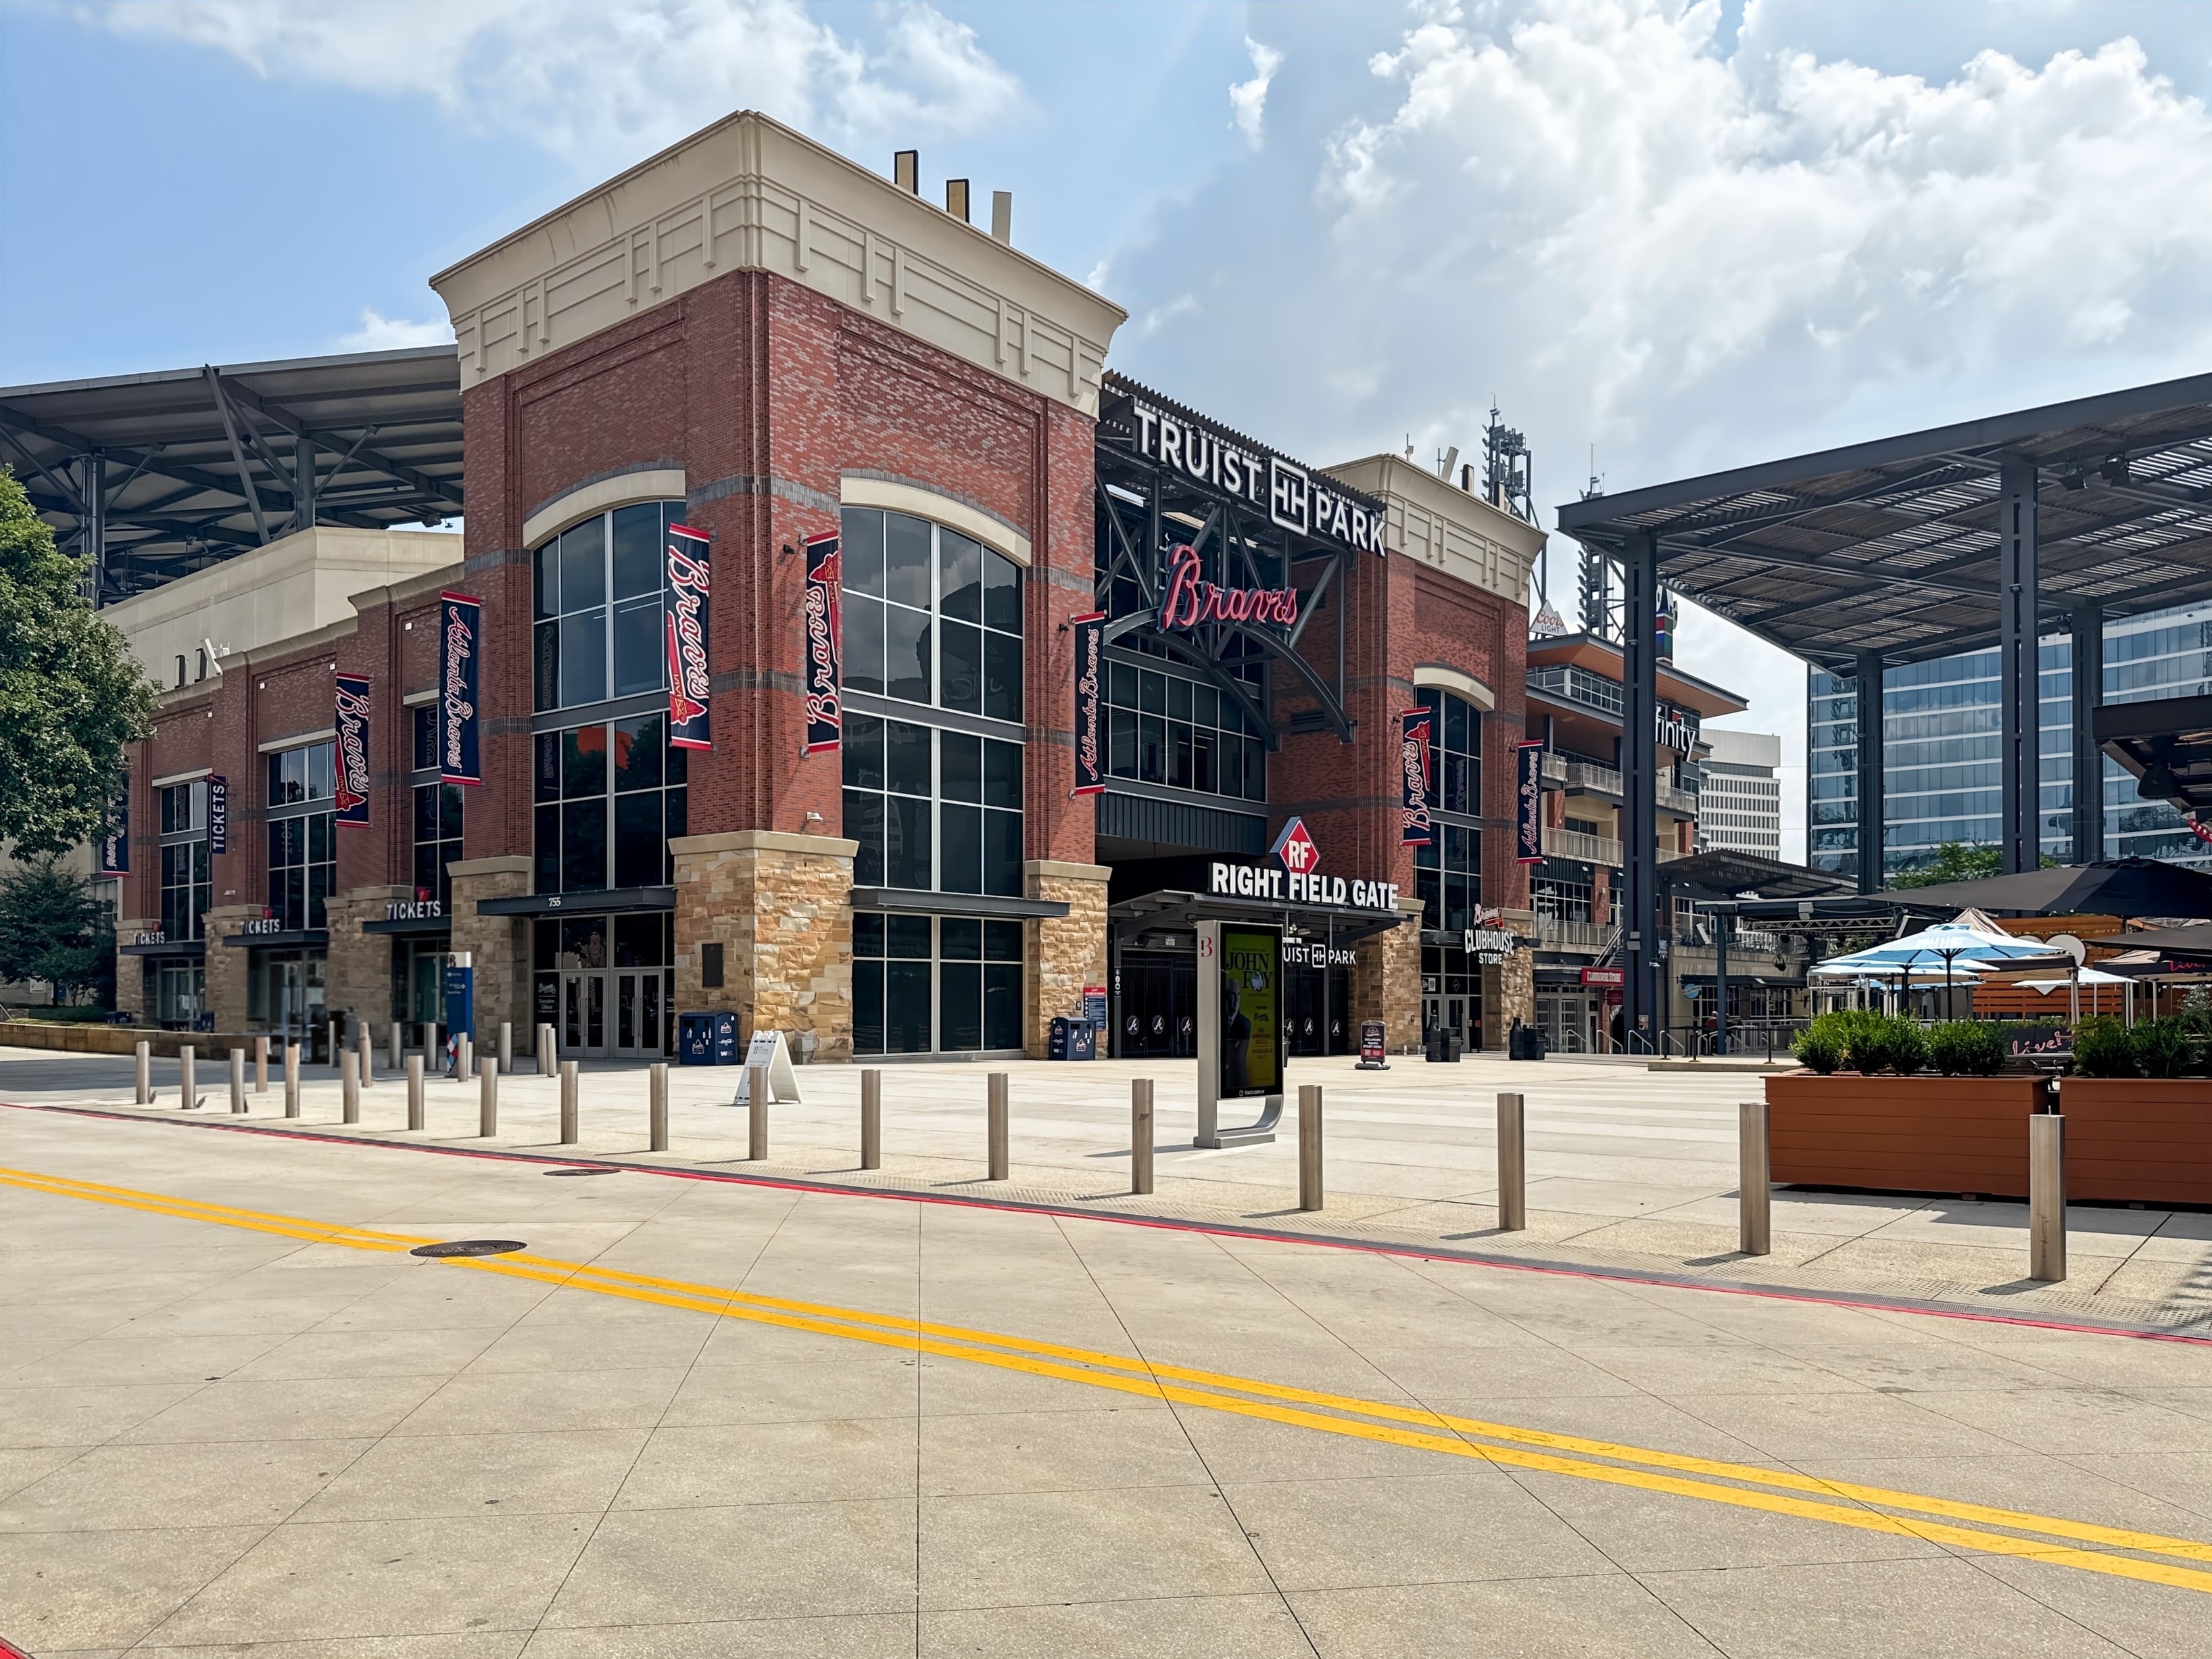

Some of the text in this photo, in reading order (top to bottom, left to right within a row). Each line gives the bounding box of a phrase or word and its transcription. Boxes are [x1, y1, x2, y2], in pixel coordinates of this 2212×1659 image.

[1133, 404, 1387, 557] TRUIST PARK
[1160, 544, 1298, 629] Braves
[668, 545, 709, 699] Braves
[1536, 610, 1564, 627] Coors
[1541, 625, 1560, 633] LIGHT
[807, 585, 840, 728] Braves
[445, 606, 473, 769] Atlanta Braves
[1079, 628, 1099, 781] Atlanta Braves
[335, 686, 370, 792] Braves
[1402, 741, 1431, 832] Braves
[1521, 750, 1539, 855] Atlanta Braves
[212, 784, 225, 850] TICKETS
[1288, 840, 1312, 869] RF
[548, 897, 561, 907] 755
[1212, 862, 1399, 909] RIGHT FIELD GATE
[240, 919, 281, 934] TICKETS
[386, 900, 441, 920] TICKETS
[133, 931, 165, 945] TICKETS
[1328, 949, 1356, 965] PARK
[1464, 929, 1515, 955] CLUBHOUSE
[1226, 951, 1270, 971] JOHN
[1478, 953, 1503, 965] STORE
